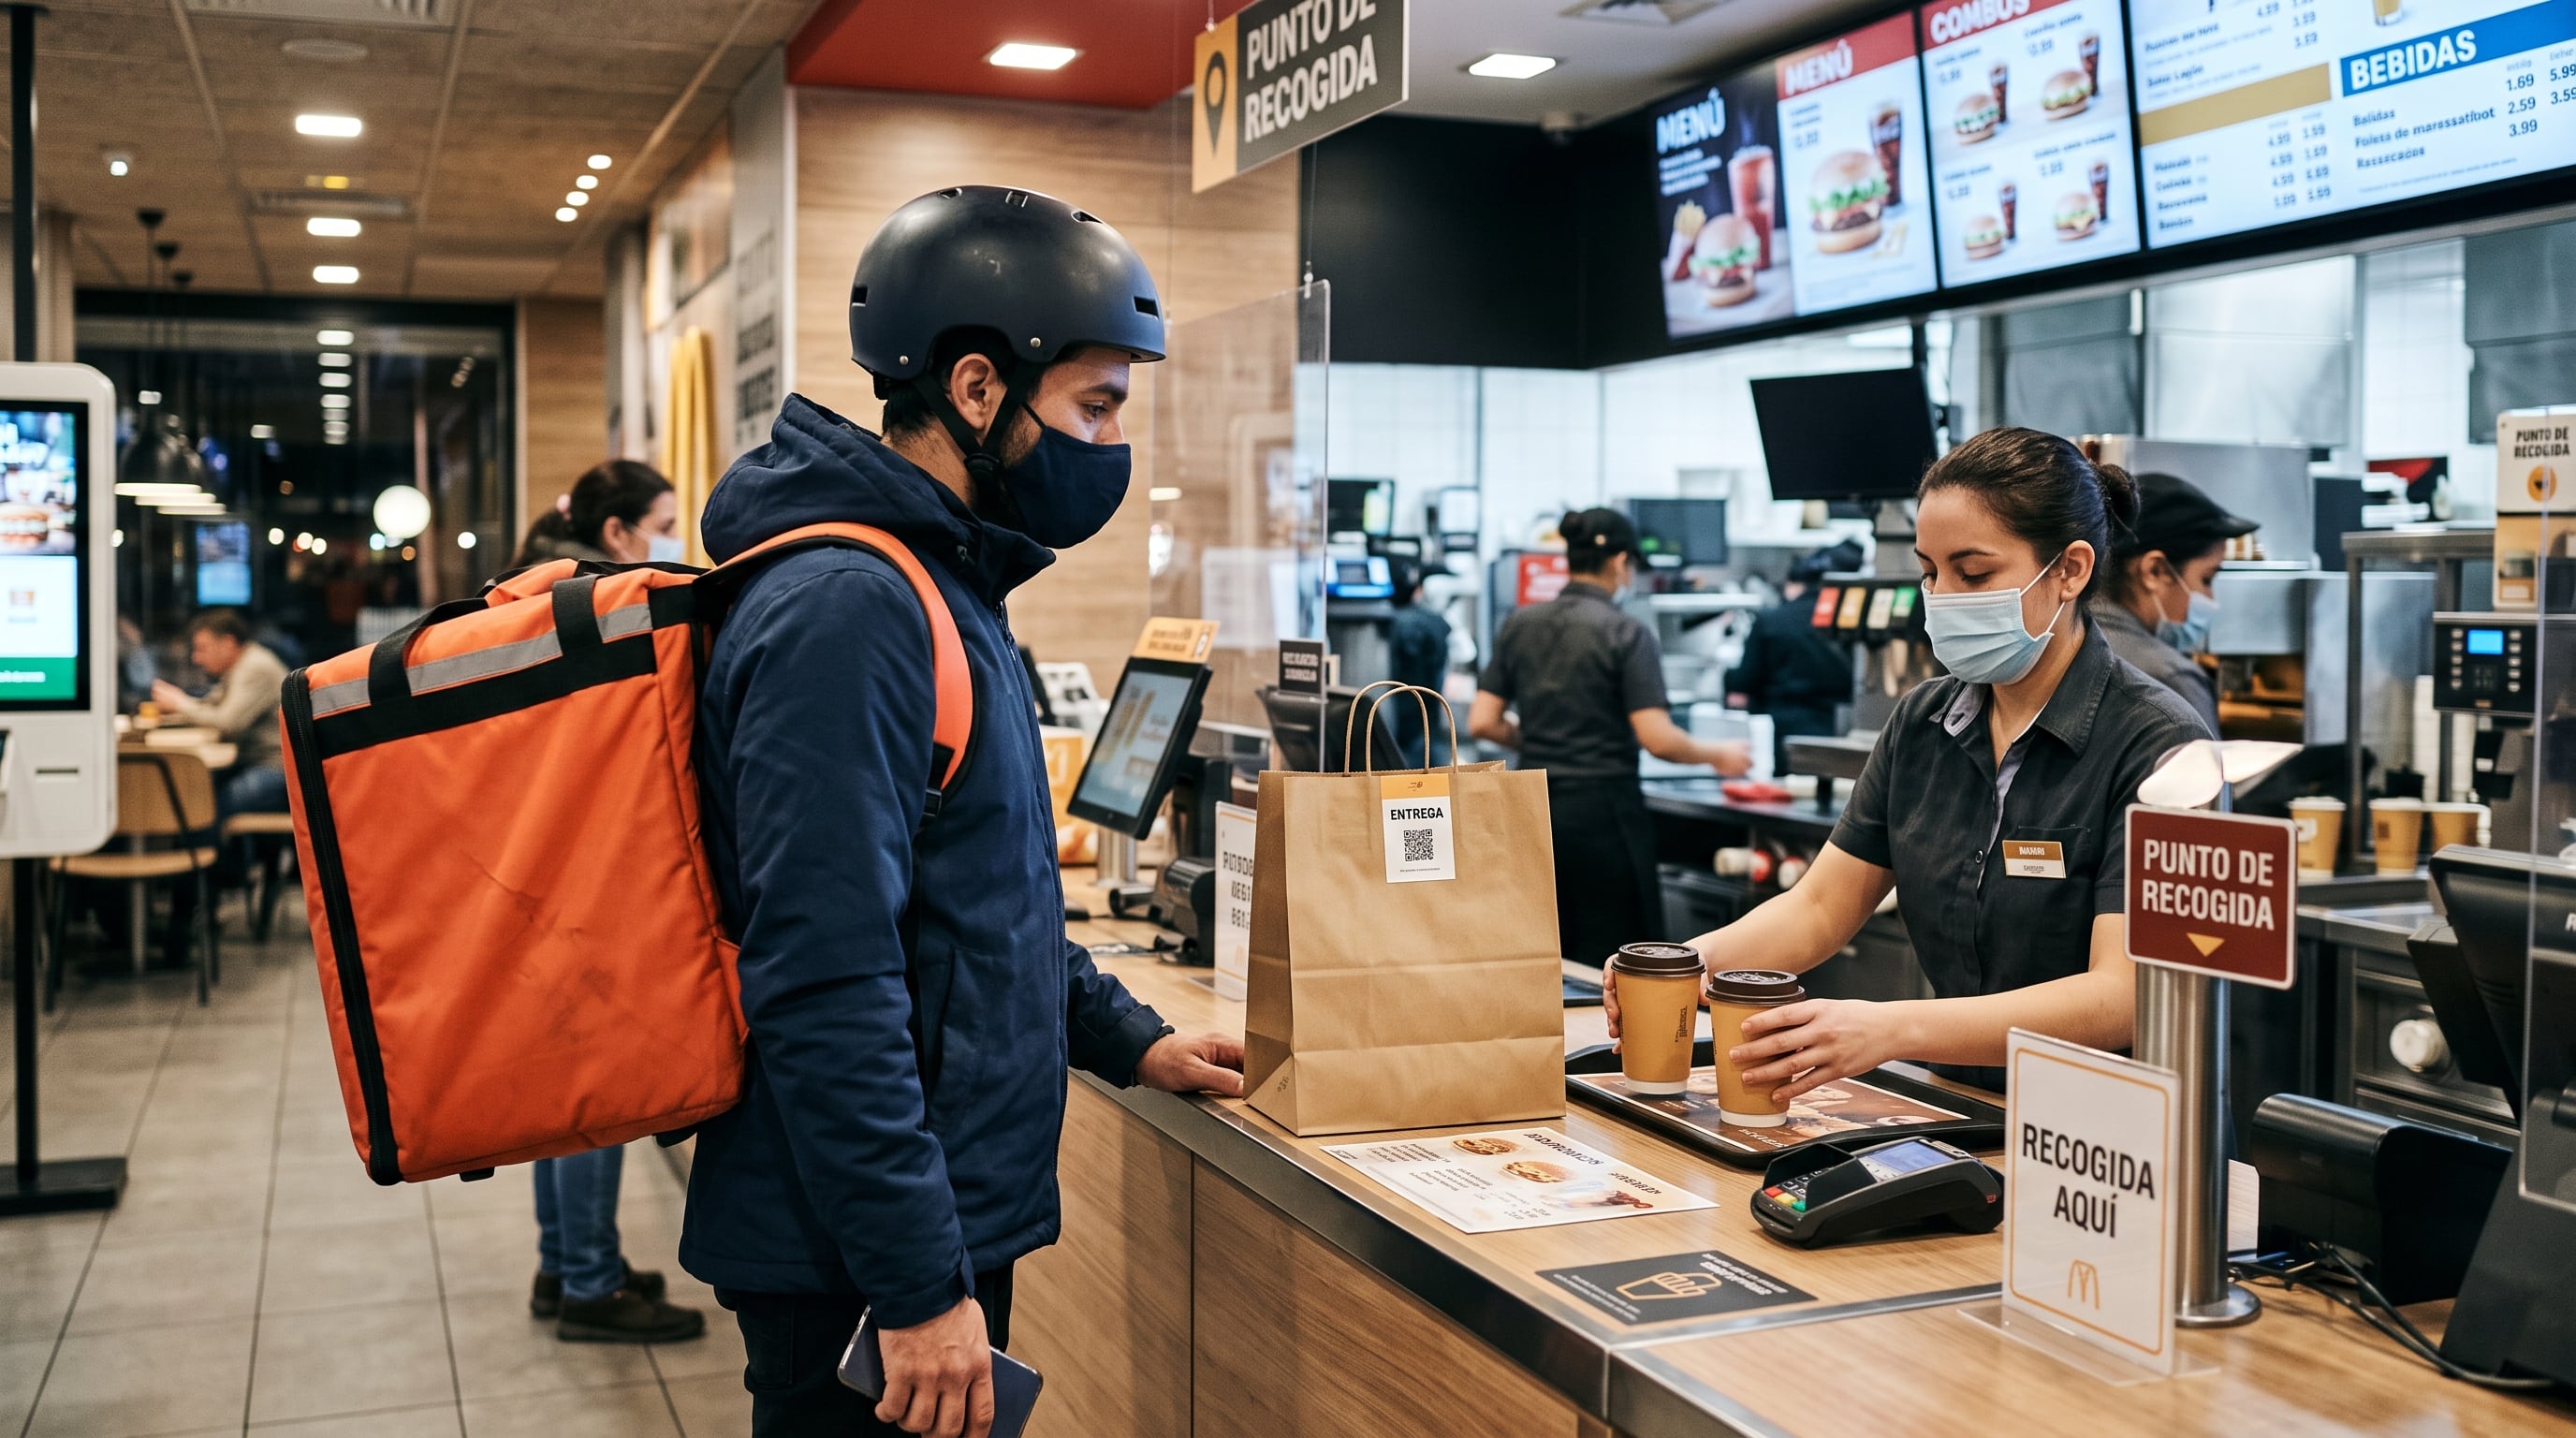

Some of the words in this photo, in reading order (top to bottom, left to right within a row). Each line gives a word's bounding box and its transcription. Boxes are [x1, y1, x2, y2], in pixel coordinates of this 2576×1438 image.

[1246, 0, 1333, 80] PUNTO
[1785, 38, 1853, 96] MENÚ
[2350, 29, 2478, 90] BEBIDAS
[1244, 34, 1378, 143] RECOGIDA
[2508, 97, 2536, 114] 2.59
[1656, 87, 1726, 154] MENÚ
[2509, 120, 2538, 138] 3.99
[2516, 428, 2552, 443] PUNTO
[2554, 426, 2569, 440] DE
[1390, 807, 1444, 820] ENTREGA
[2144, 839, 2230, 881] PUNTO
[2239, 850, 2274, 887] DE
[2142, 878, 2275, 931] RECOGIDA
[2022, 1123, 2155, 1200] RECOGIDA
[2054, 1184, 2118, 1239] AQUÍ
